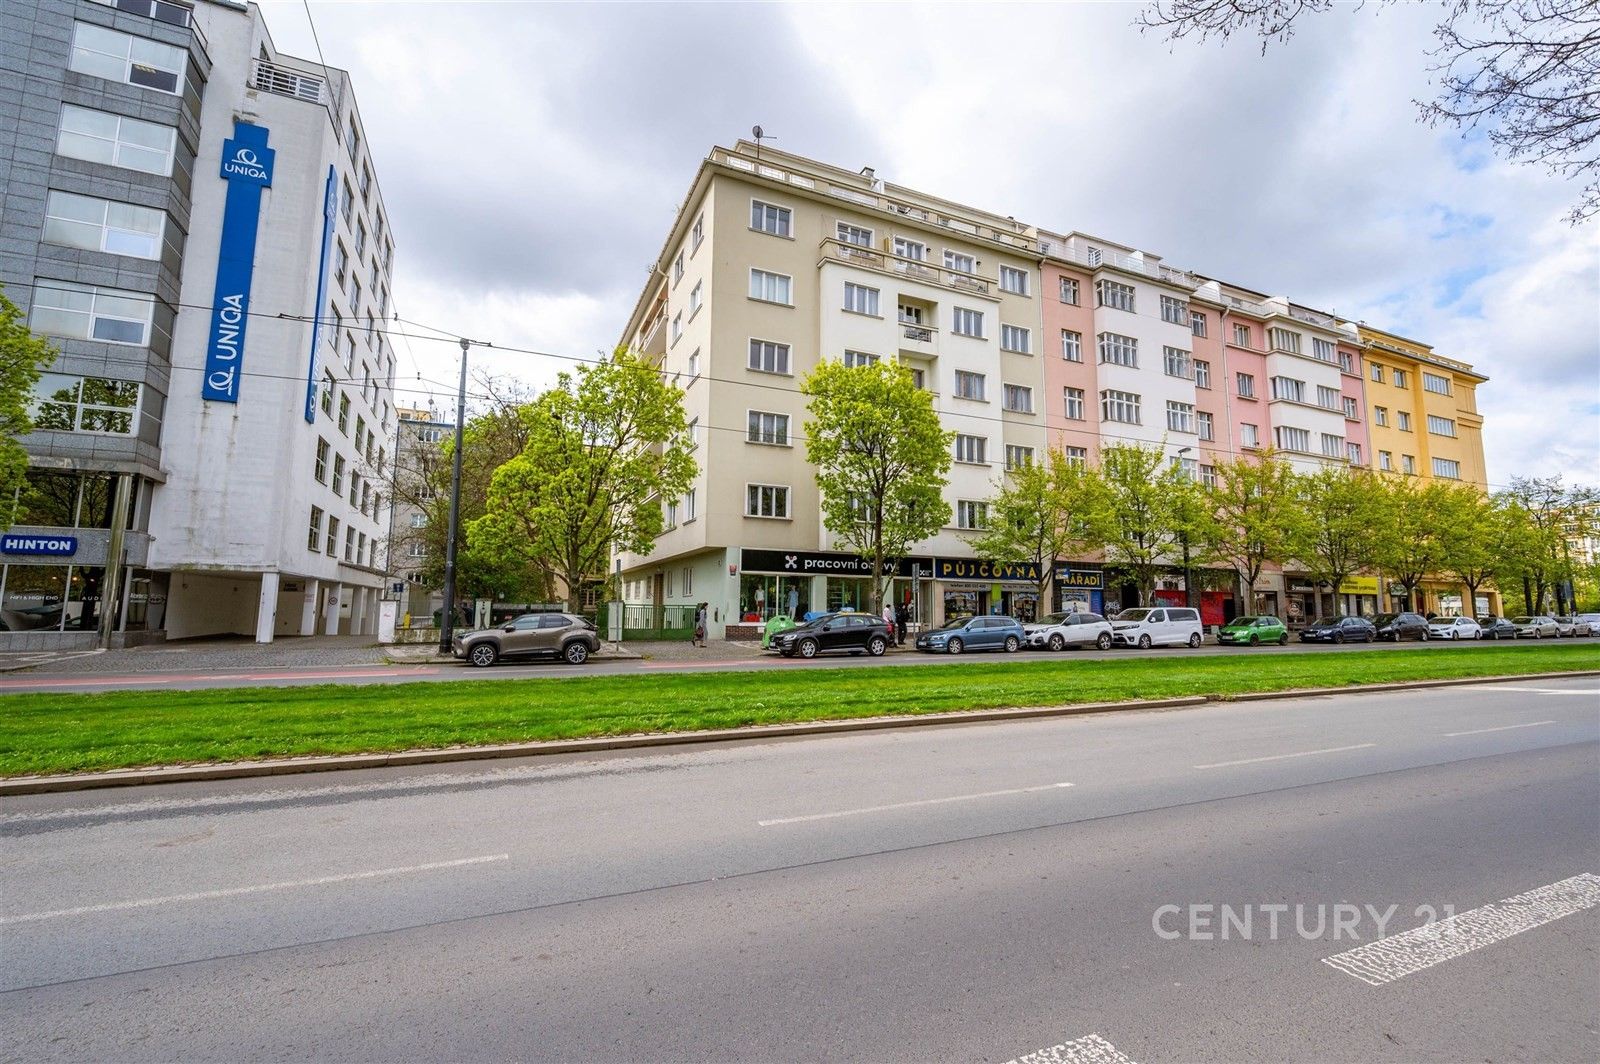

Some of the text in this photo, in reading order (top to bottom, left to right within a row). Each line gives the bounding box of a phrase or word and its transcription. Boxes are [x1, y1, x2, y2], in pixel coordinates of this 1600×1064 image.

[224, 163, 267, 180] UNIQA
[215, 294, 244, 361] UNIQA
[5, 539, 71, 550] HINTON
[804, 558, 858, 570] pracovní
[943, 560, 1037, 578] PŮJČOVNA
